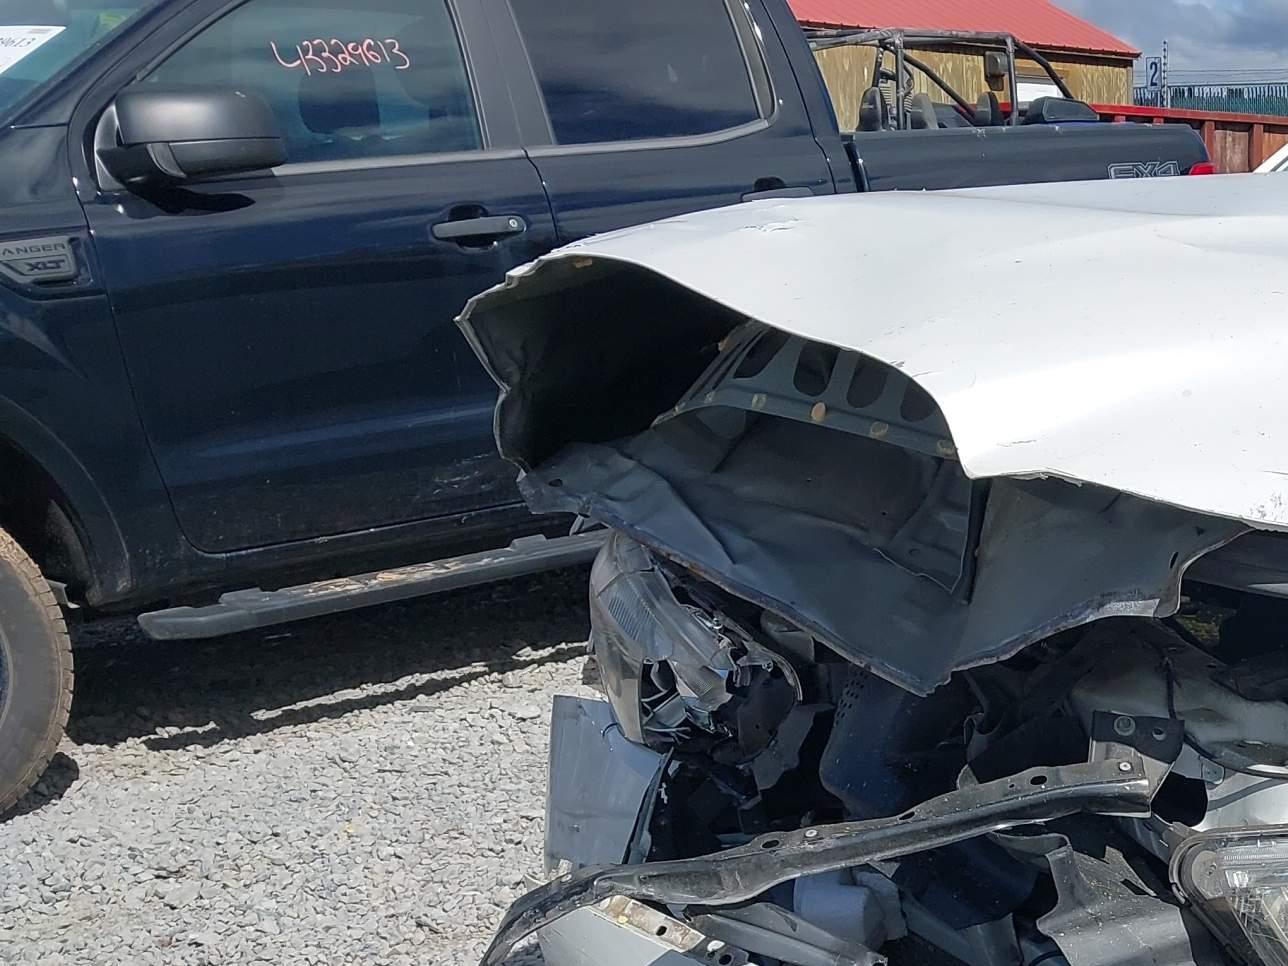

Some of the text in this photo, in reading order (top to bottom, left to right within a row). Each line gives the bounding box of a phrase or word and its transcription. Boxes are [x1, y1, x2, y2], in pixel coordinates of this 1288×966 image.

[270, 38, 410, 76] 43329613
[1149, 61, 1159, 87] 2
[1, 243, 66, 256] ANGER
[24, 260, 65, 272] XLT
